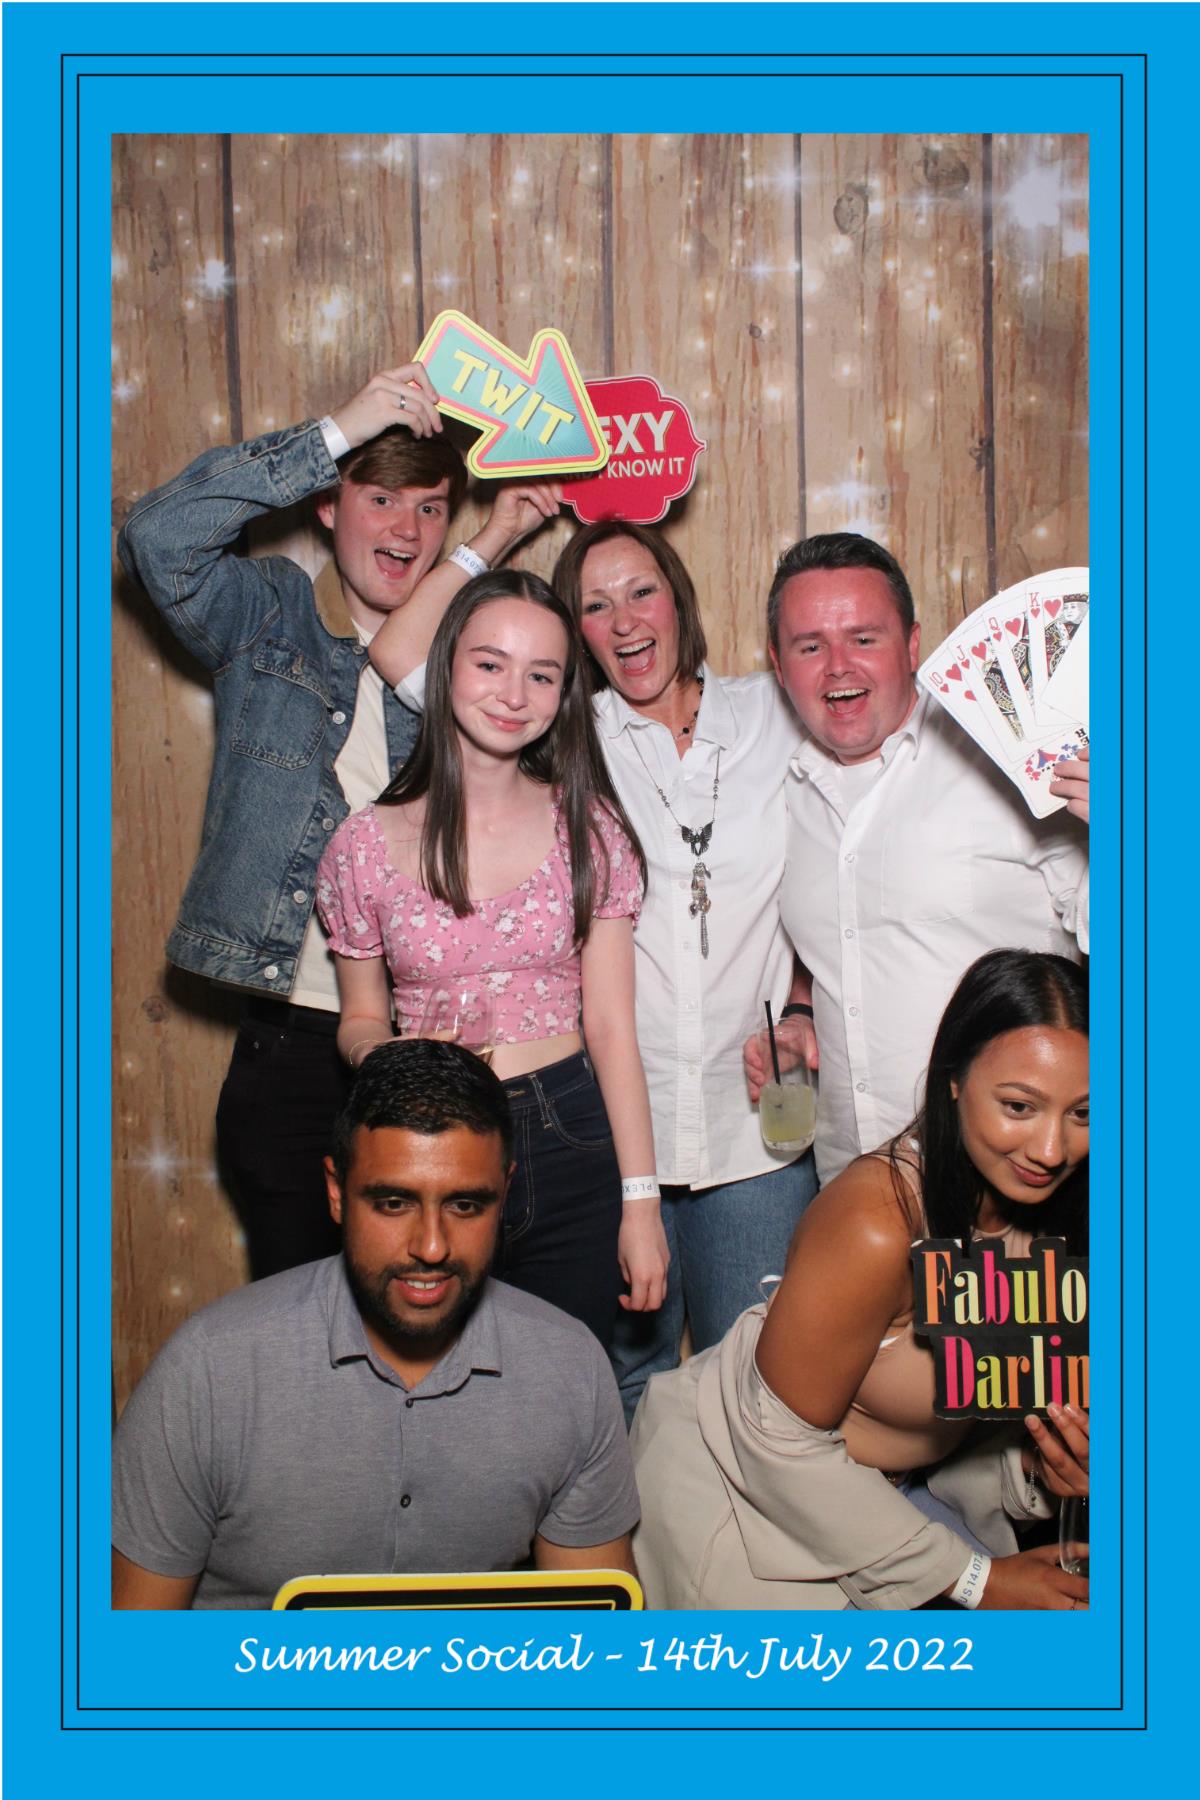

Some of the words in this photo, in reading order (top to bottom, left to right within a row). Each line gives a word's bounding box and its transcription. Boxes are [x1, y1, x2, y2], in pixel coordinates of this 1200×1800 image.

[452, 349, 576, 446] TWIT
[607, 458, 665, 478] KNOW
[668, 457, 685, 475] IT
[1029, 592, 1040, 607] K
[989, 617, 1000, 630] Q
[956, 645, 965, 660] J
[921, 1249, 1087, 1325] Fabulo
